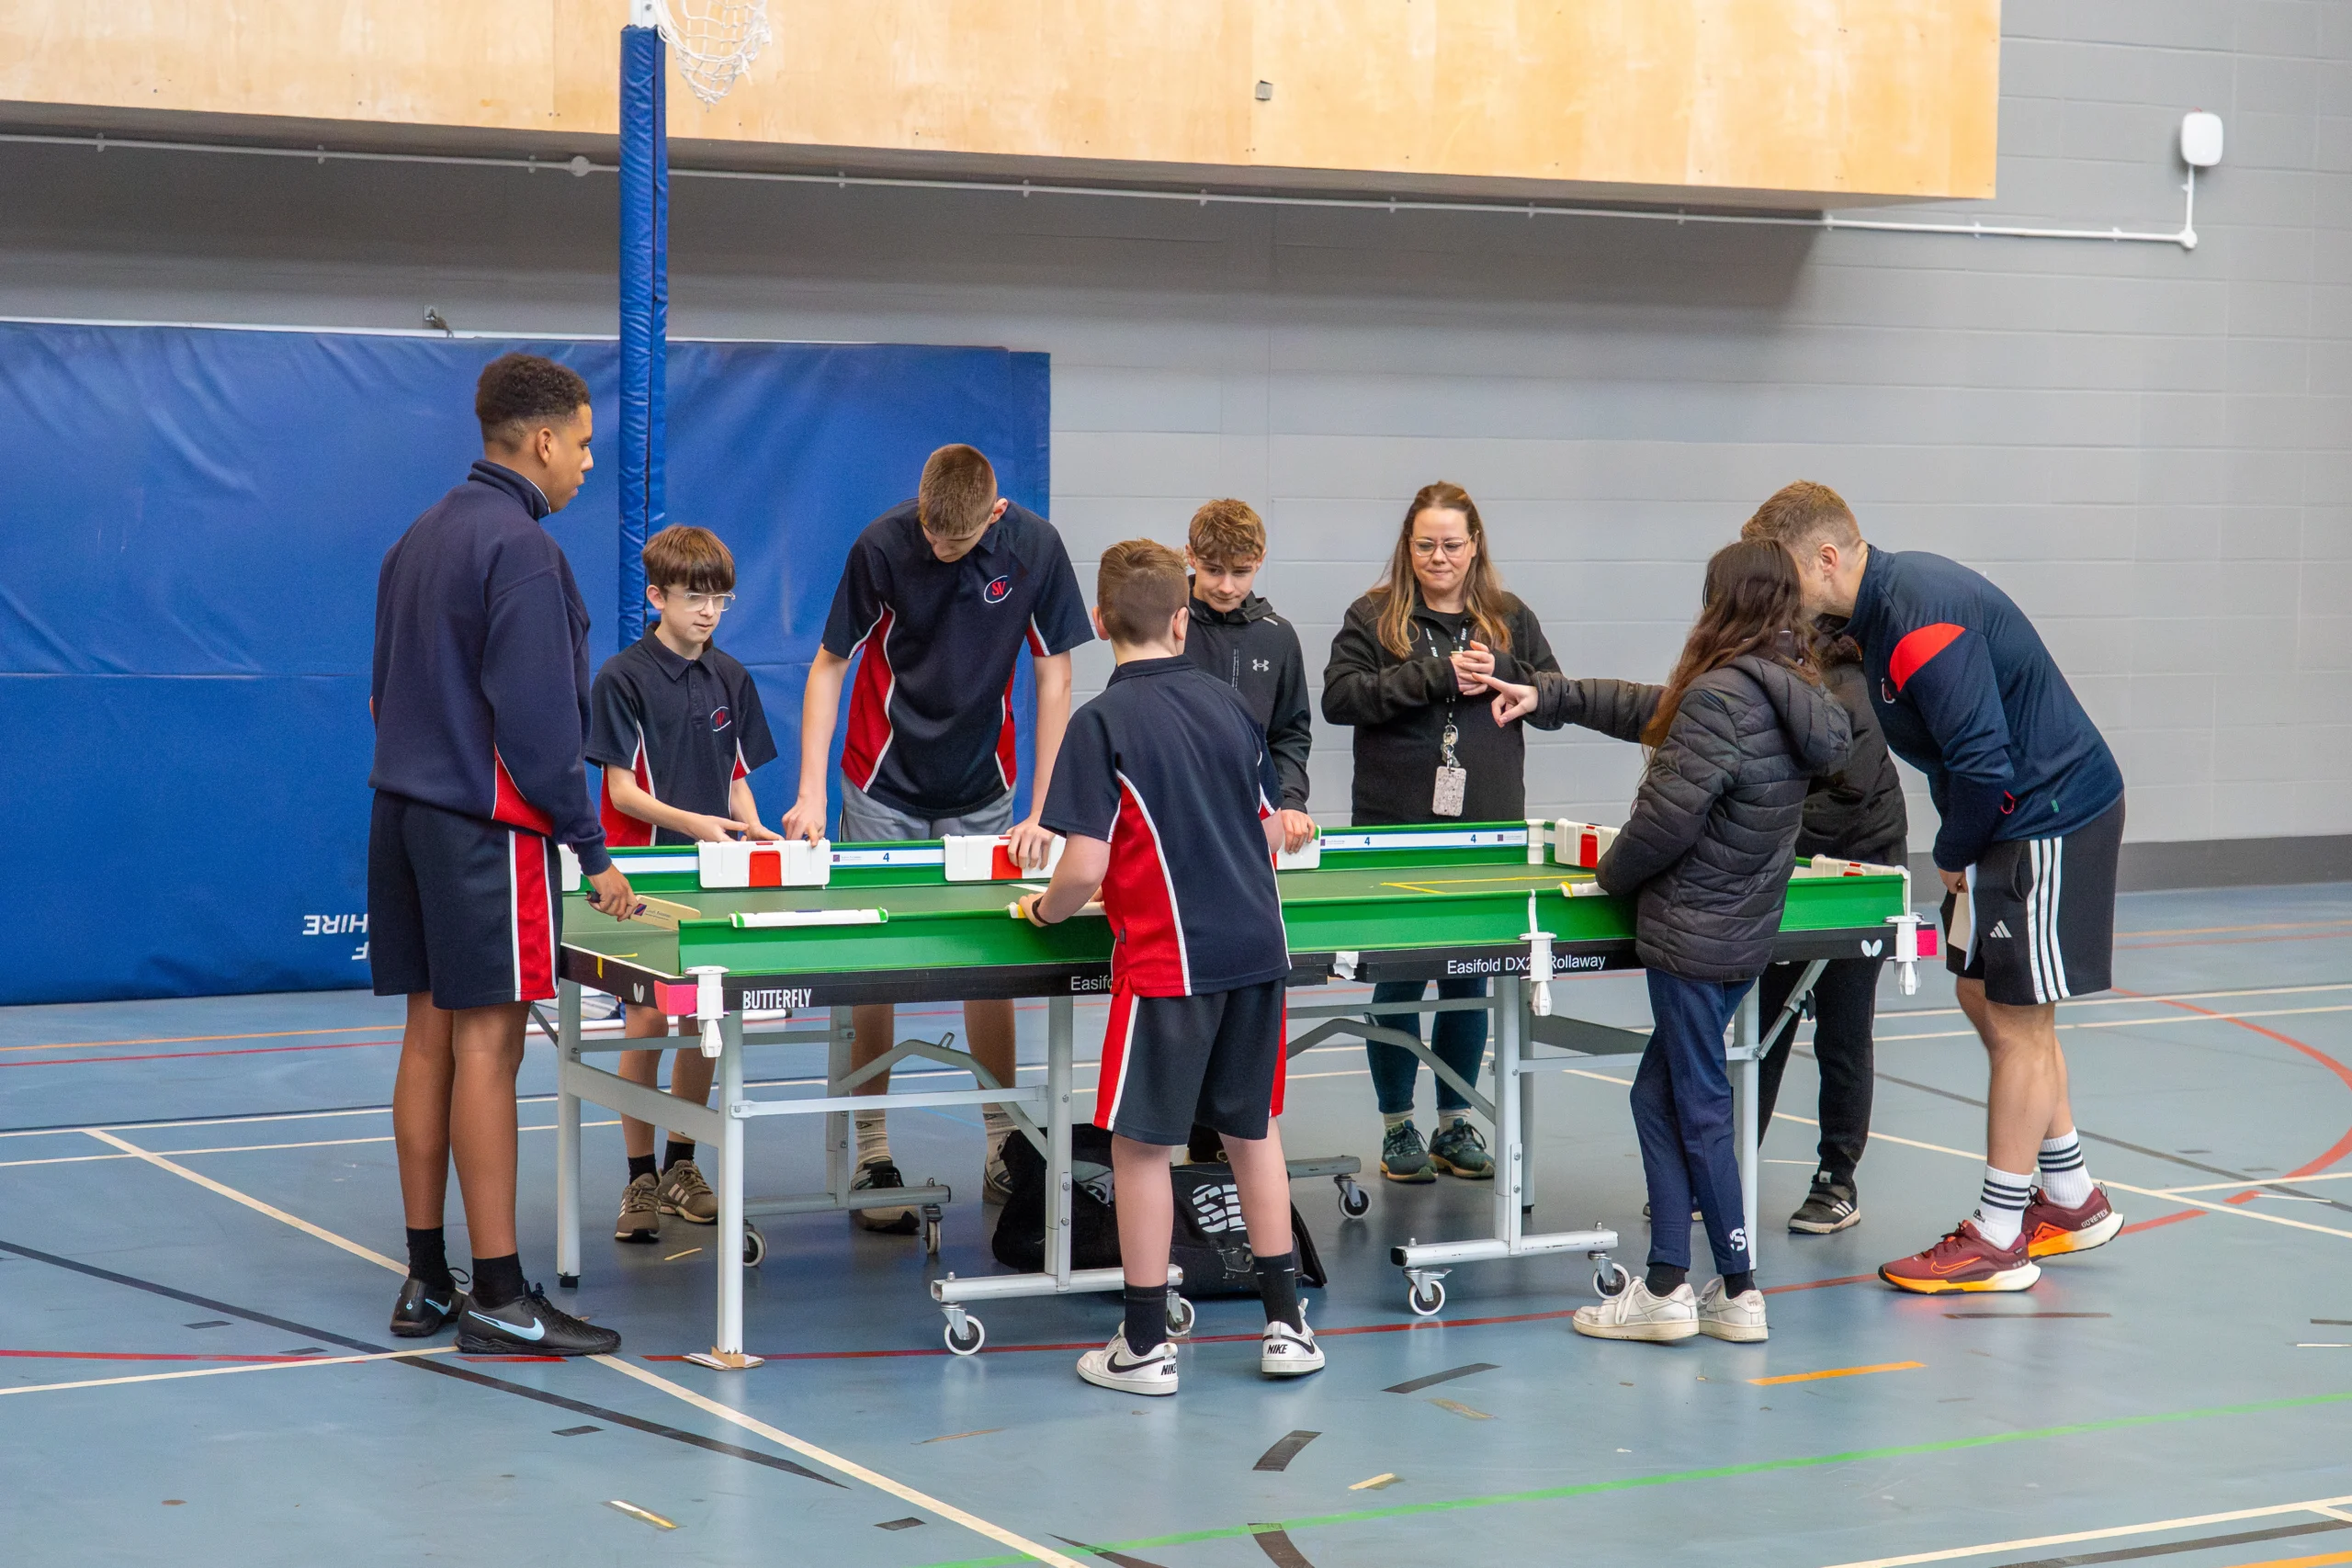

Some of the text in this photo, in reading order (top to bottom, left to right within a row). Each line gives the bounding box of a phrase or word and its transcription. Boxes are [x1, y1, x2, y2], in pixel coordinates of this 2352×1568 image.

[1363, 837, 1371, 846] 4
[1470, 834, 1477, 843] 4
[882, 852, 890, 863] 4
[1447, 957, 1501, 975] Easifold
[1551, 954, 1606, 970] Rollaway
[742, 988, 812, 1010] BUTTERFLY
[1267, 1344, 1288, 1355] NIKE
[1160, 1362, 1177, 1376] NIKE
